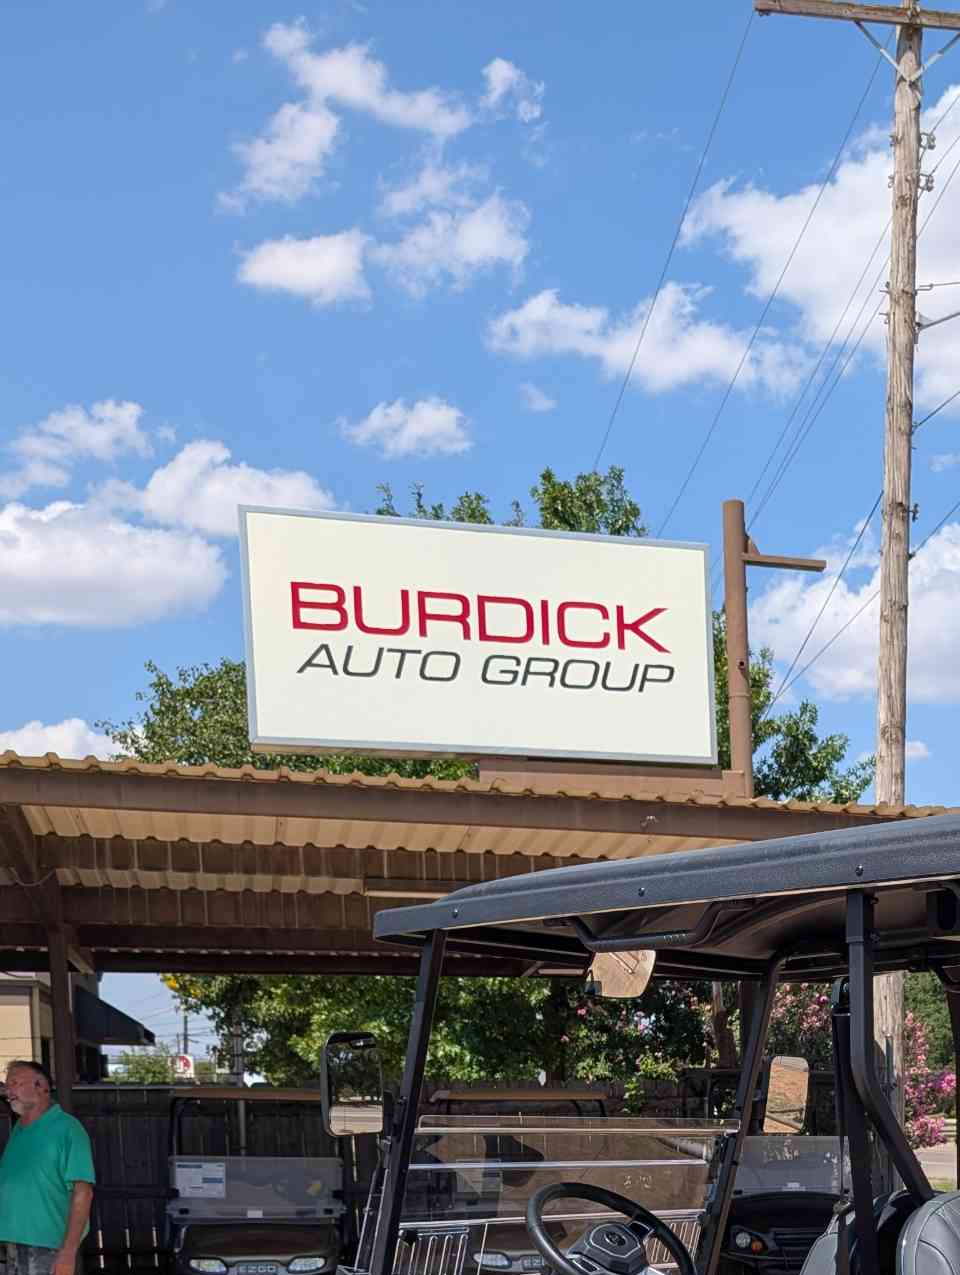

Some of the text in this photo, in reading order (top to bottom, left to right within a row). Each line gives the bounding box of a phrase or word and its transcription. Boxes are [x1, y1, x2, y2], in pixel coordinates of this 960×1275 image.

[290, 581, 671, 654] BURDICK
[296, 643, 675, 693] AUTO GROUP
